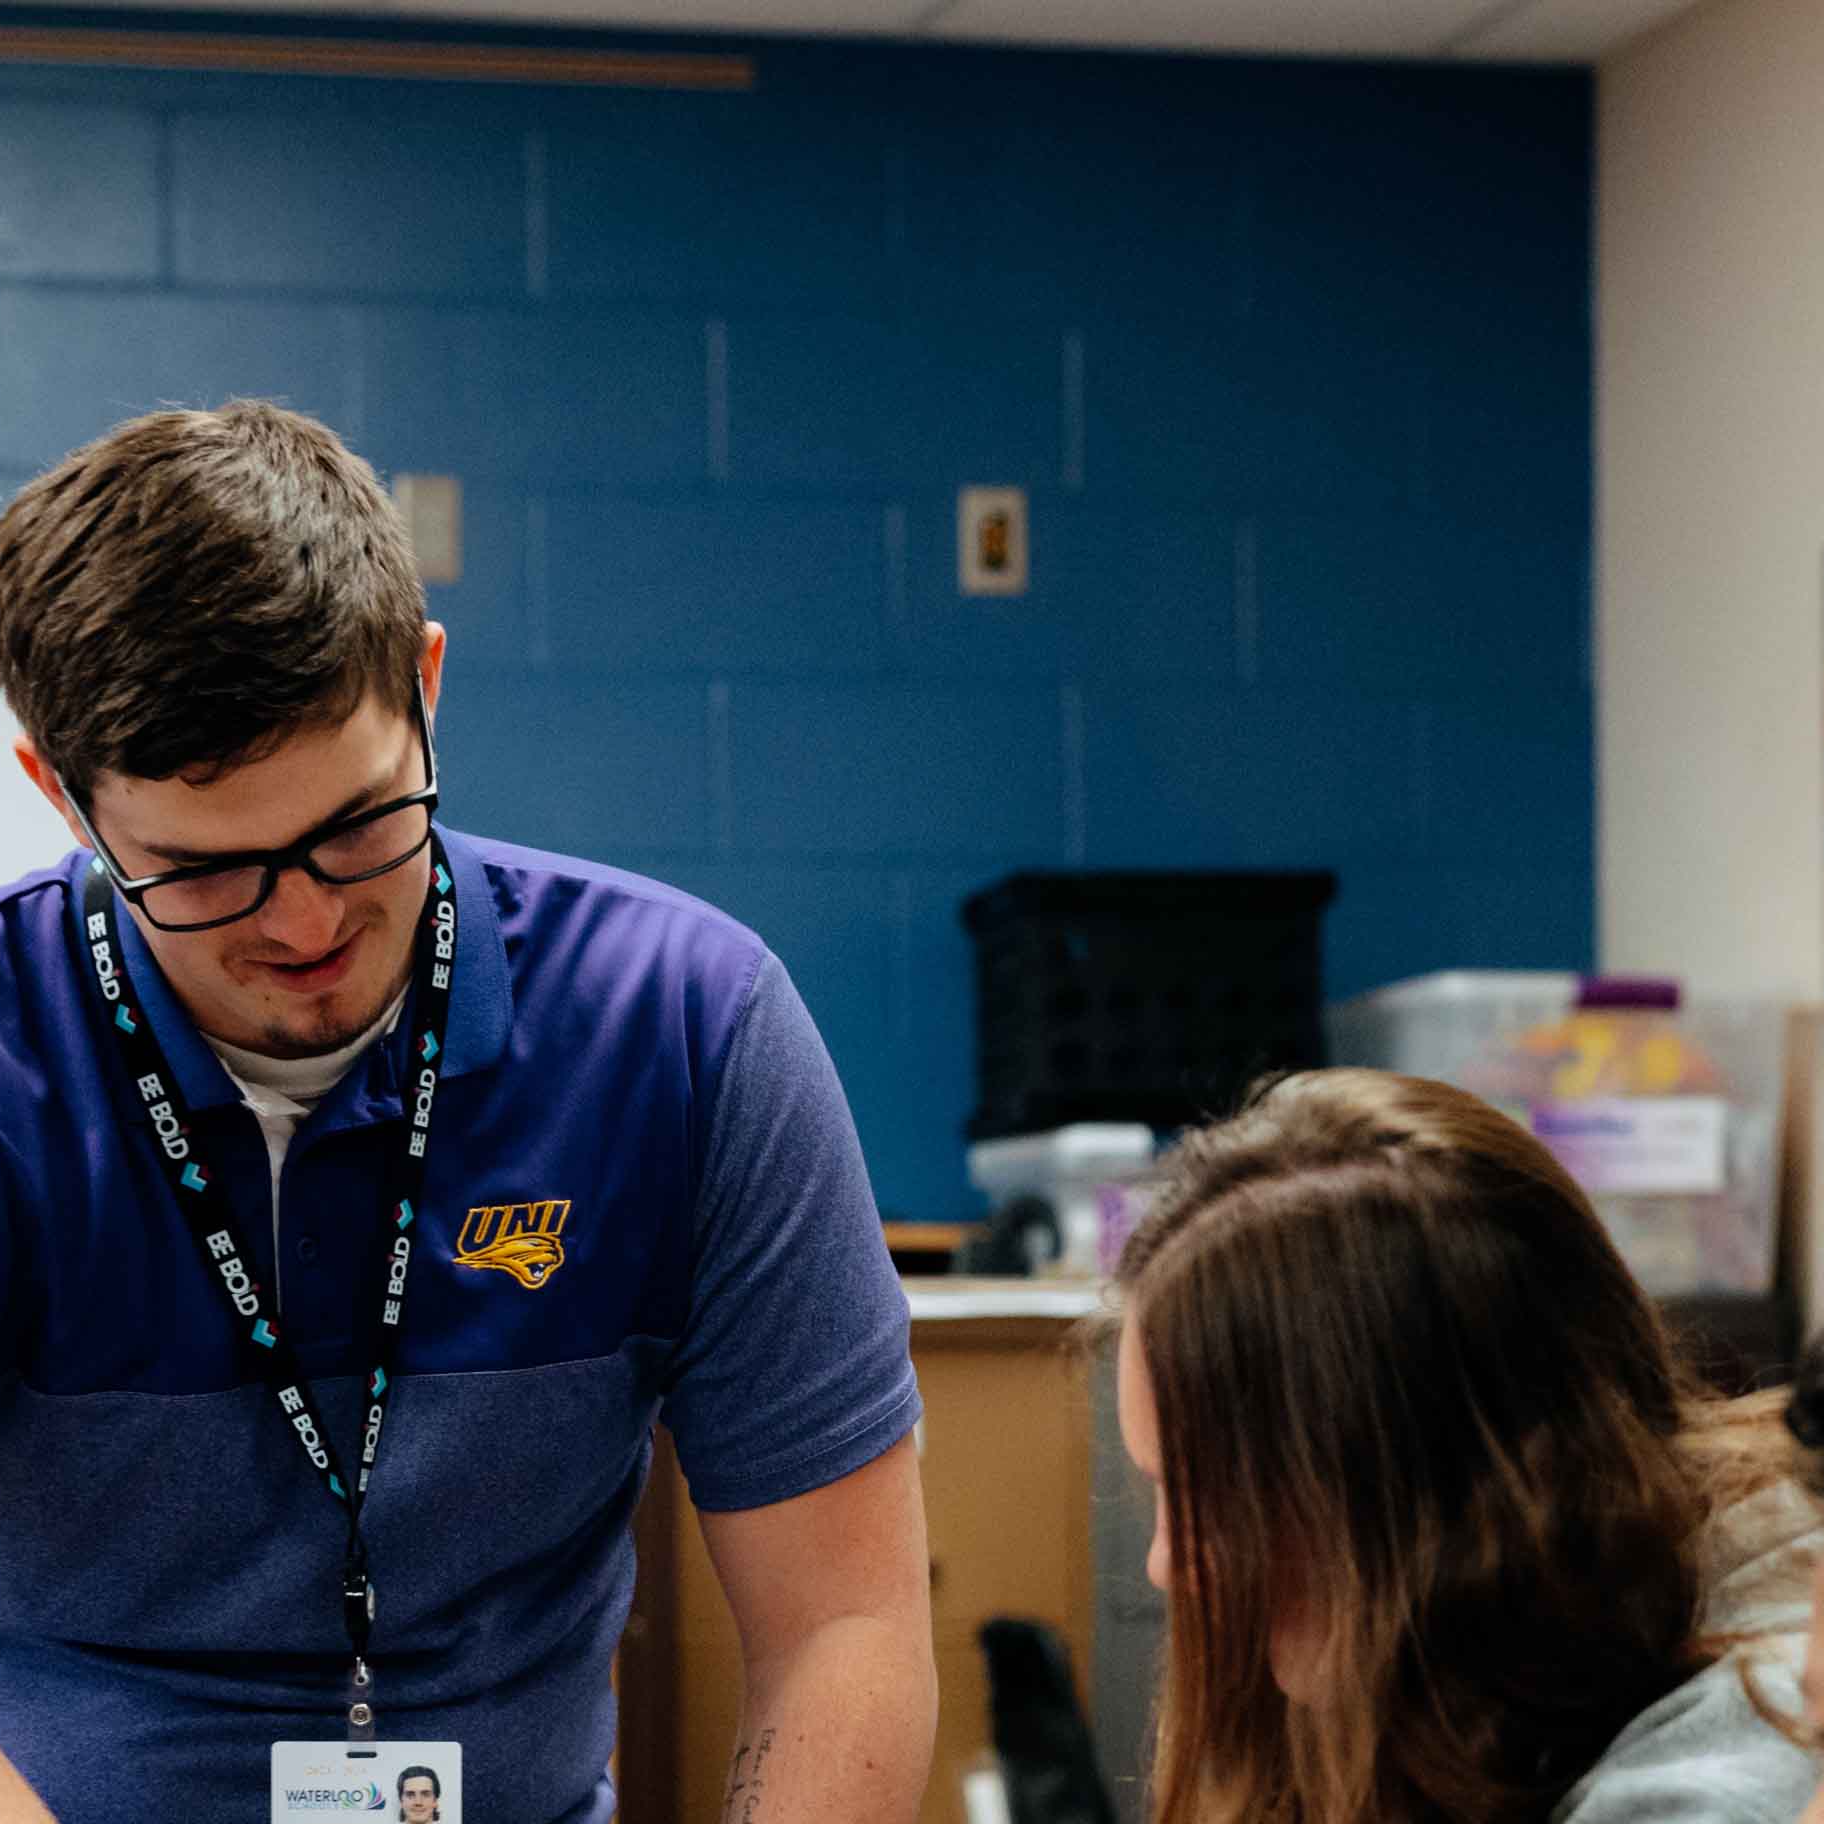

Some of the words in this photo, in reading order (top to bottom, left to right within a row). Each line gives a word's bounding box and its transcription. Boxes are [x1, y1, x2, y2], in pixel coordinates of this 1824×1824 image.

[86, 911, 108, 941] BE
[435, 900, 455, 960] BOLD
[91, 940, 121, 1001] BOLD
[431, 962, 450, 990] BE
[137, 1073, 165, 1102] BE
[413, 1068, 436, 1128] BOLD
[149, 1101, 189, 1160] BOLD
[409, 1131, 427, 1158] BE
[206, 1229, 236, 1259] BE
[457, 1199, 572, 1257] UNI
[219, 1257, 260, 1316] BOLD
[388, 1236, 410, 1296] BOLD
[383, 1299, 401, 1325] BE
[278, 1386, 305, 1414] BE
[292, 1413, 329, 1469] BOLD
[362, 1404, 382, 1463] BOLD
[285, 1789, 364, 1804] WATERLOO
